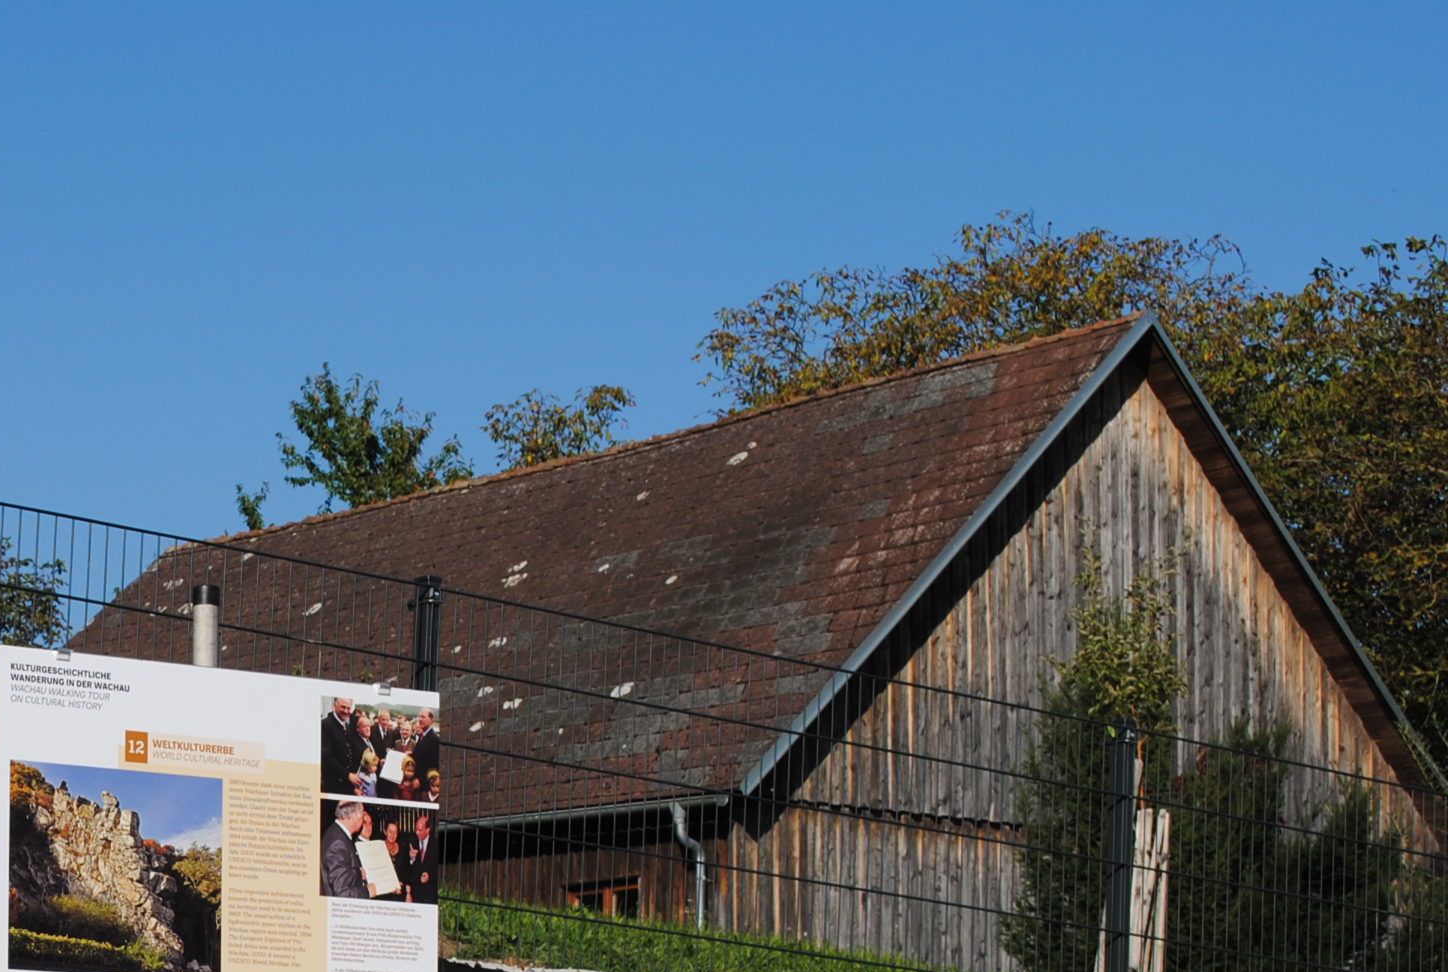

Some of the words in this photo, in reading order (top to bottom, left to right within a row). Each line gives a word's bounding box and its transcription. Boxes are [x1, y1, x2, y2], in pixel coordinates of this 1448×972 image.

[11, 663, 111, 680] KULTURGESCHICHTLICHE
[11, 673, 64, 685] WANDERUNG
[66, 679, 74, 687] IN
[76, 680, 92, 688] DER
[94, 682, 130, 692] WACHAU
[11, 684, 47, 694] WACHAU
[48, 688, 86, 698] WALKING
[88, 691, 111, 701] TOUR
[10, 694, 23, 703] ON
[25, 695, 66, 707] CULTURAL
[68, 700, 103, 711] HISTORY
[128, 740, 145, 754] 12
[152, 739, 234, 755] WELTKULTURERBE
[152, 751, 182, 760] WORLD
[183, 753, 222, 764] CULTURAL
[224, 758, 260, 768] HERITAGE
